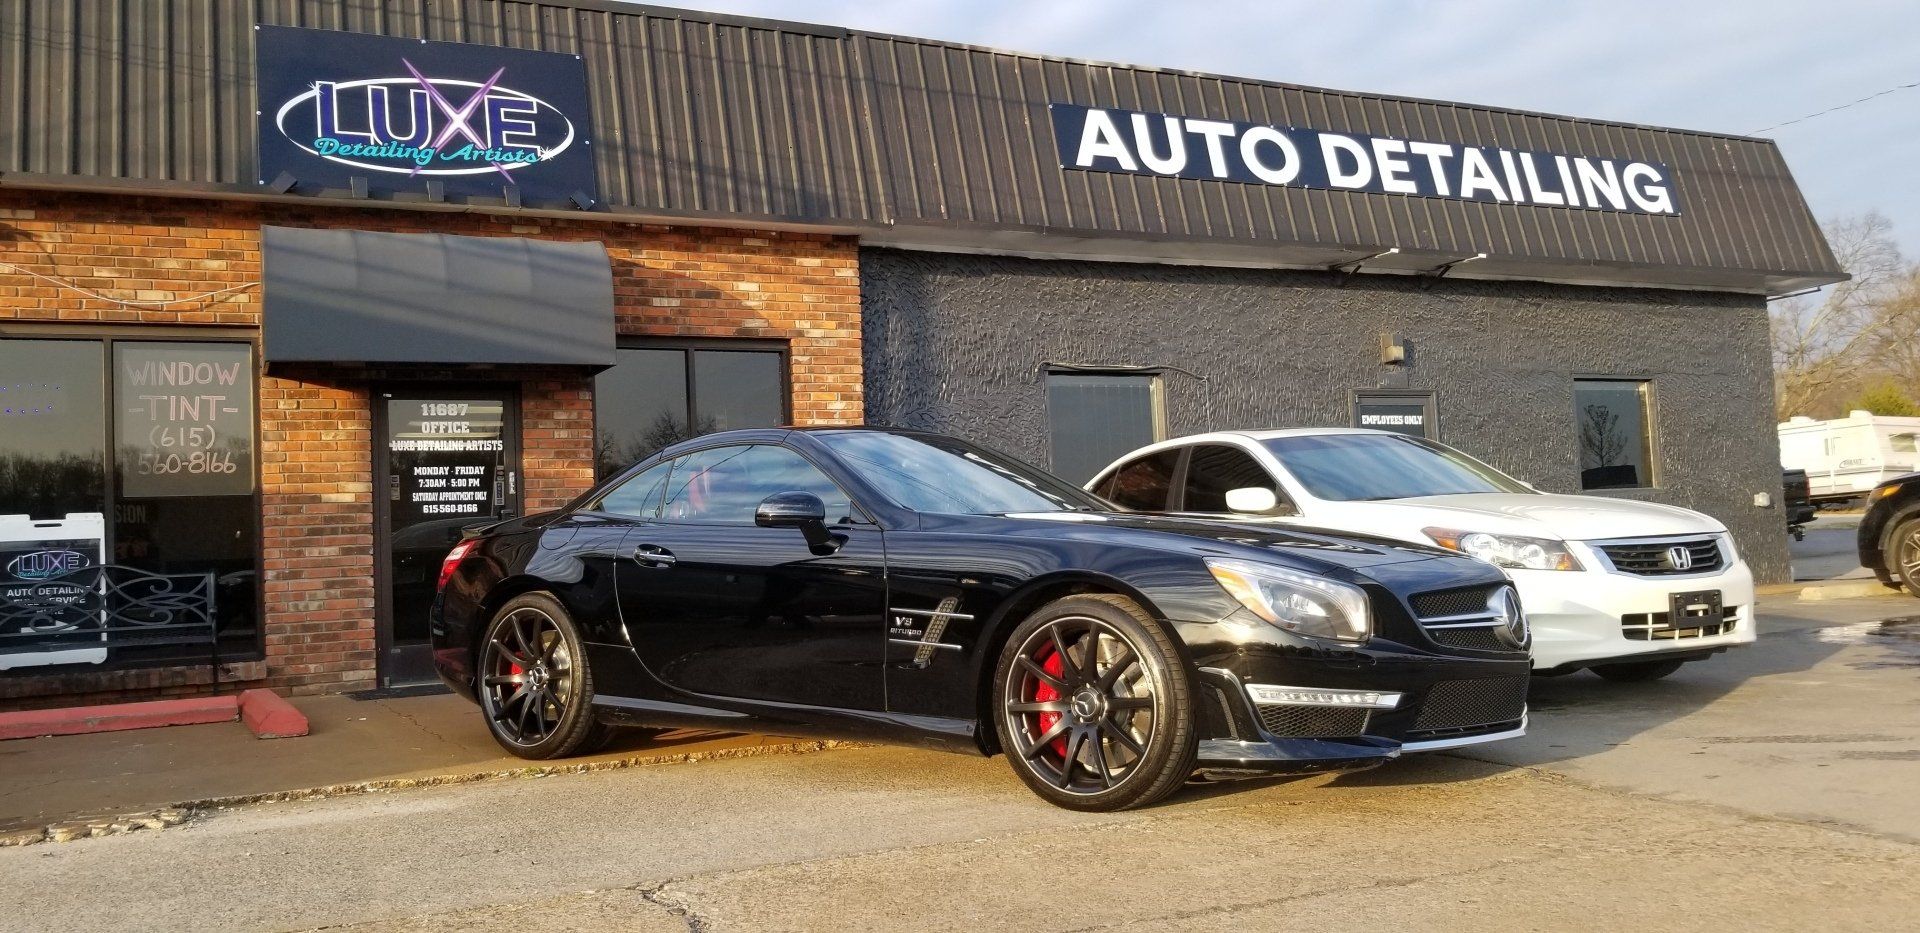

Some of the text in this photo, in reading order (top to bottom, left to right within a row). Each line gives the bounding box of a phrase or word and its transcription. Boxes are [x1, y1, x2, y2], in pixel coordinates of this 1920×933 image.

[315, 72, 540, 162] LUXE
[314, 138, 540, 165] Detailing Artists
[1076, 109, 1675, 214] AUTO DETAILING
[125, 361, 240, 386] WINDOW
[421, 404, 468, 416] 11687
[1361, 415, 1422, 425] EMPLOYEES ONLY
[421, 421, 470, 434] OFFICE
[150, 424, 216, 450] (615)
[391, 440, 503, 451] LUXE DETAILING ARTISTS
[138, 451, 237, 474] 560-8166
[414, 466, 449, 475] MONDAY
[455, 466, 485, 475] FRIDAY
[419, 479, 446, 488] 7:30AM
[451, 479, 467, 487] 5:00
[468, 479, 480, 487] PM
[412, 492, 439, 502] SATURDAY
[439, 491, 474, 501] APPOINTMENT
[475, 491, 487, 500] ONLY
[423, 504, 478, 513] 615-560-8166
[17, 552, 80, 573] LUXE
[38, 585, 91, 596] DETAILIN
[896, 616, 912, 626] V8
